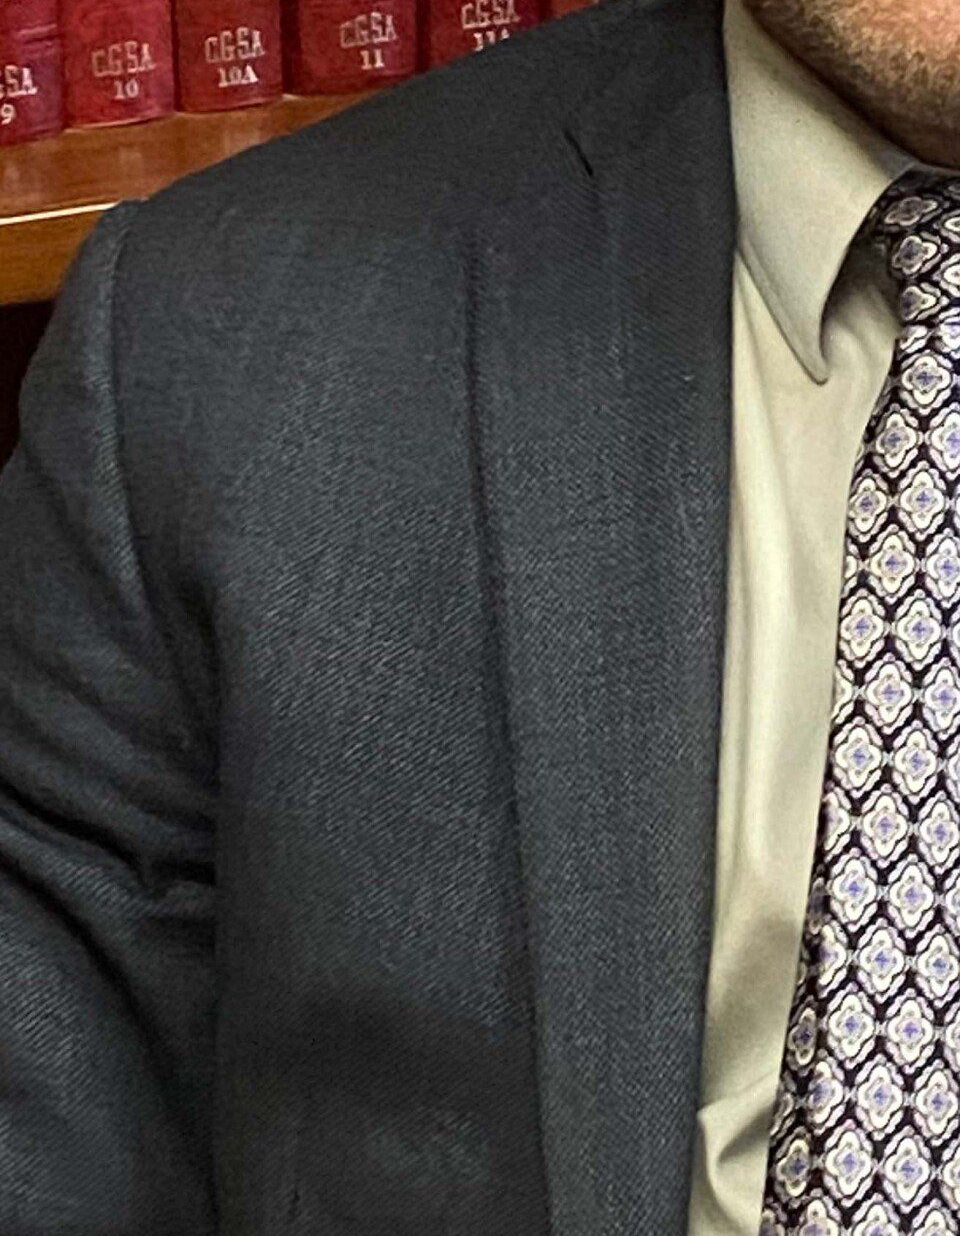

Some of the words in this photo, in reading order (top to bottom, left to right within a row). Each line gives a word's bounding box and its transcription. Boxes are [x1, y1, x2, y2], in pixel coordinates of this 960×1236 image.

[204, 26, 266, 63] CGSA
[340, 11, 398, 48] CGSA
[91, 40, 156, 78] CGSA
[360, 48, 385, 70] 11
[112, 78, 140, 101] 10
[217, 65, 259, 88] 10A
